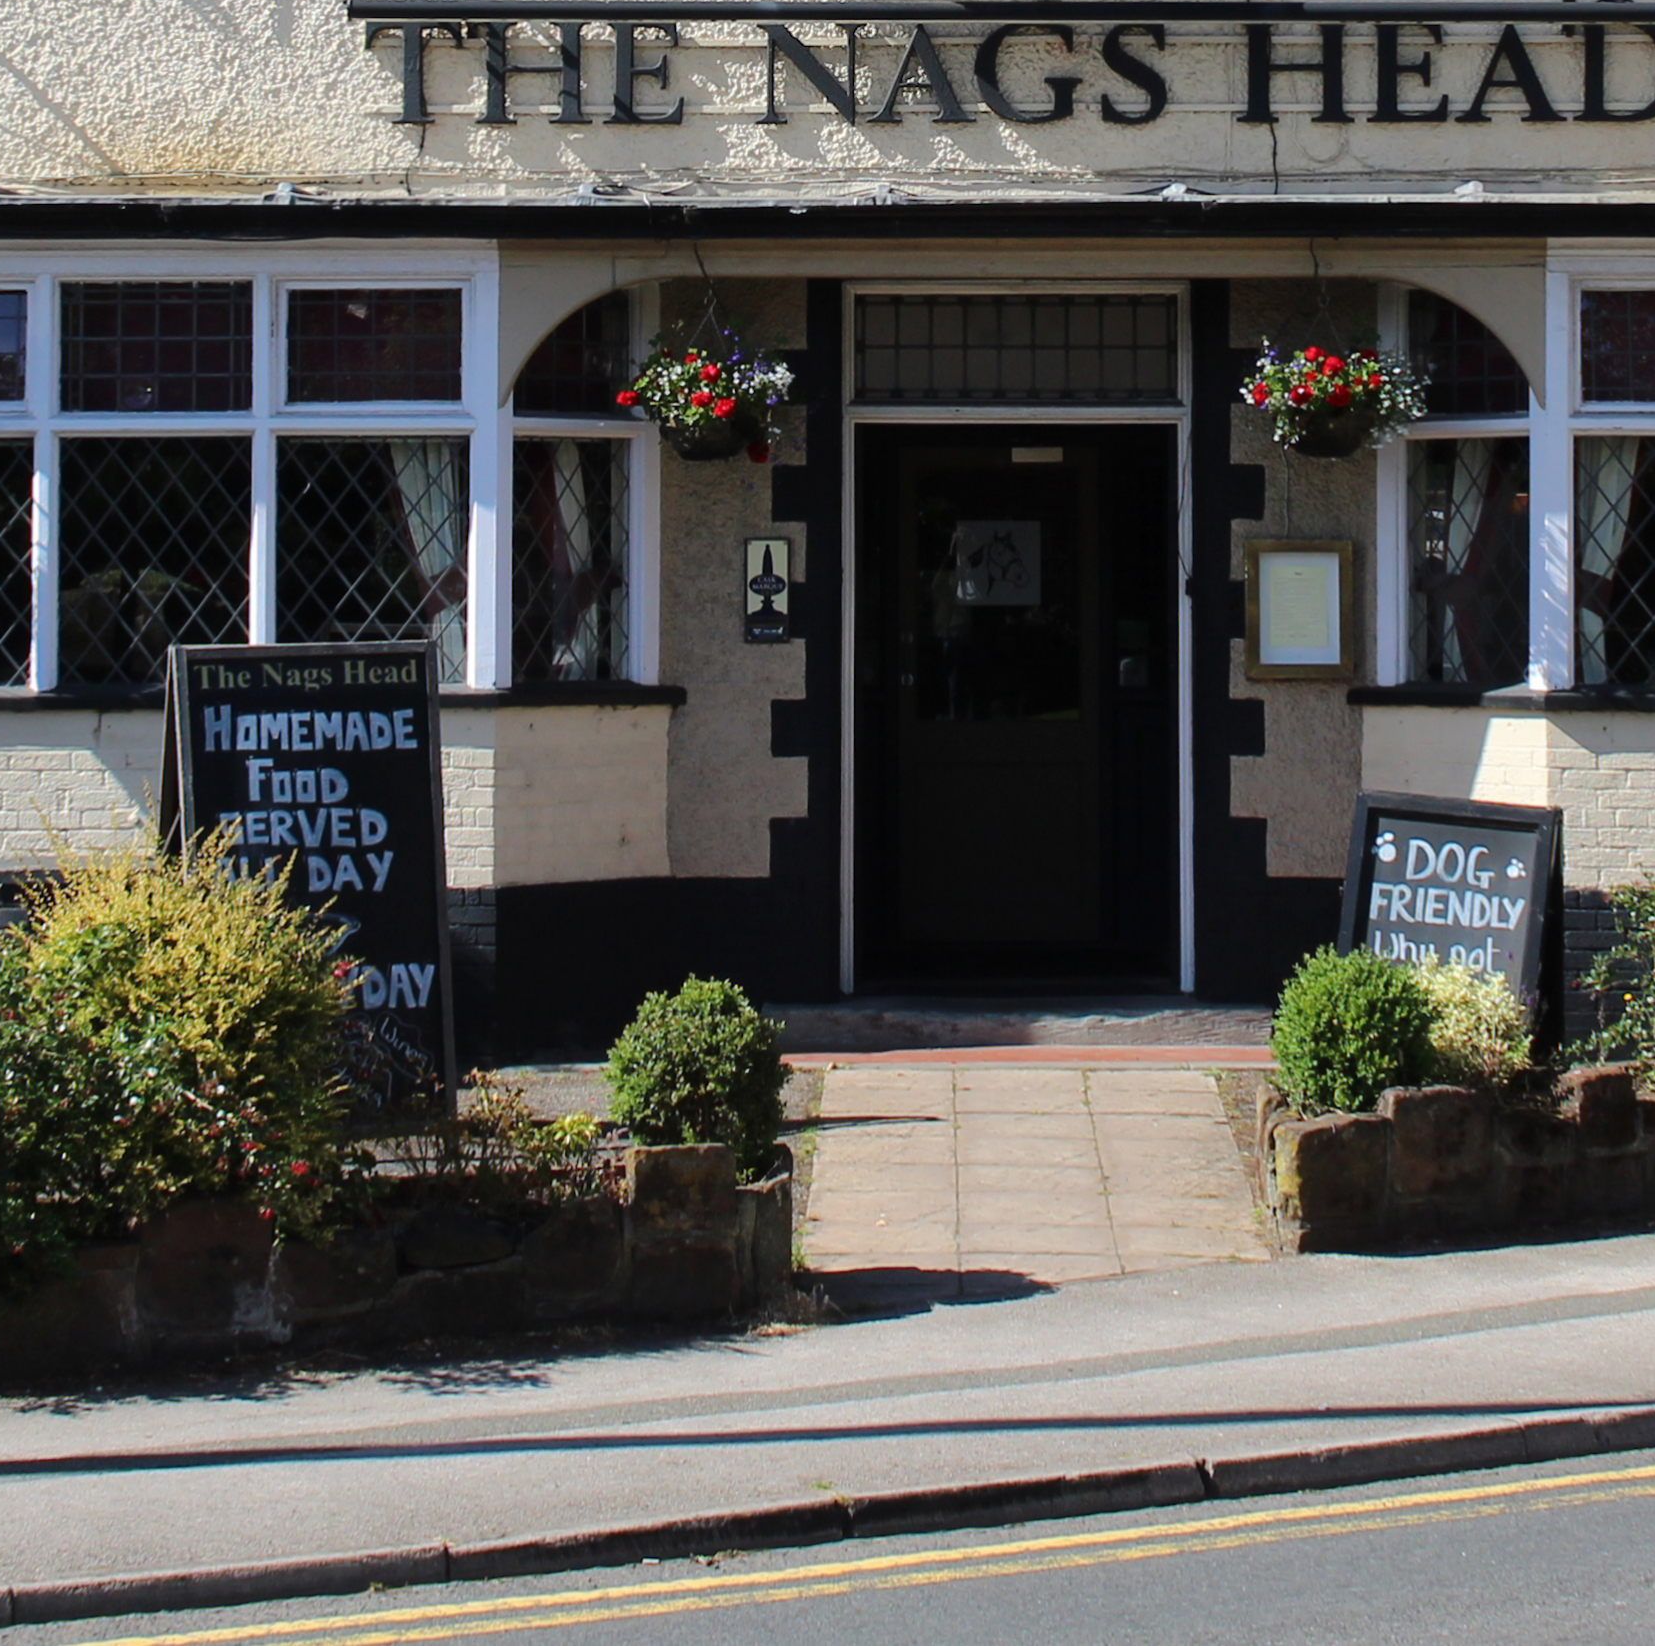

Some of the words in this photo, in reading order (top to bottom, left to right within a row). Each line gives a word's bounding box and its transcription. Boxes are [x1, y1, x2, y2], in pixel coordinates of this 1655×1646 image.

[364, 21, 687, 125] THE
[760, 21, 1169, 125] NAGS
[194, 665, 252, 690] The
[262, 662, 333, 691] Nags
[344, 659, 419, 686] Head
[203, 704, 419, 751] HOMEMADE
[246, 756, 350, 804] FOOD
[219, 808, 389, 848] SERVED
[307, 851, 394, 892] DAY
[1405, 838, 1495, 889] DOG
[1370, 881, 1526, 931] FRIENDLY
[1450, 936, 1502, 974] not
